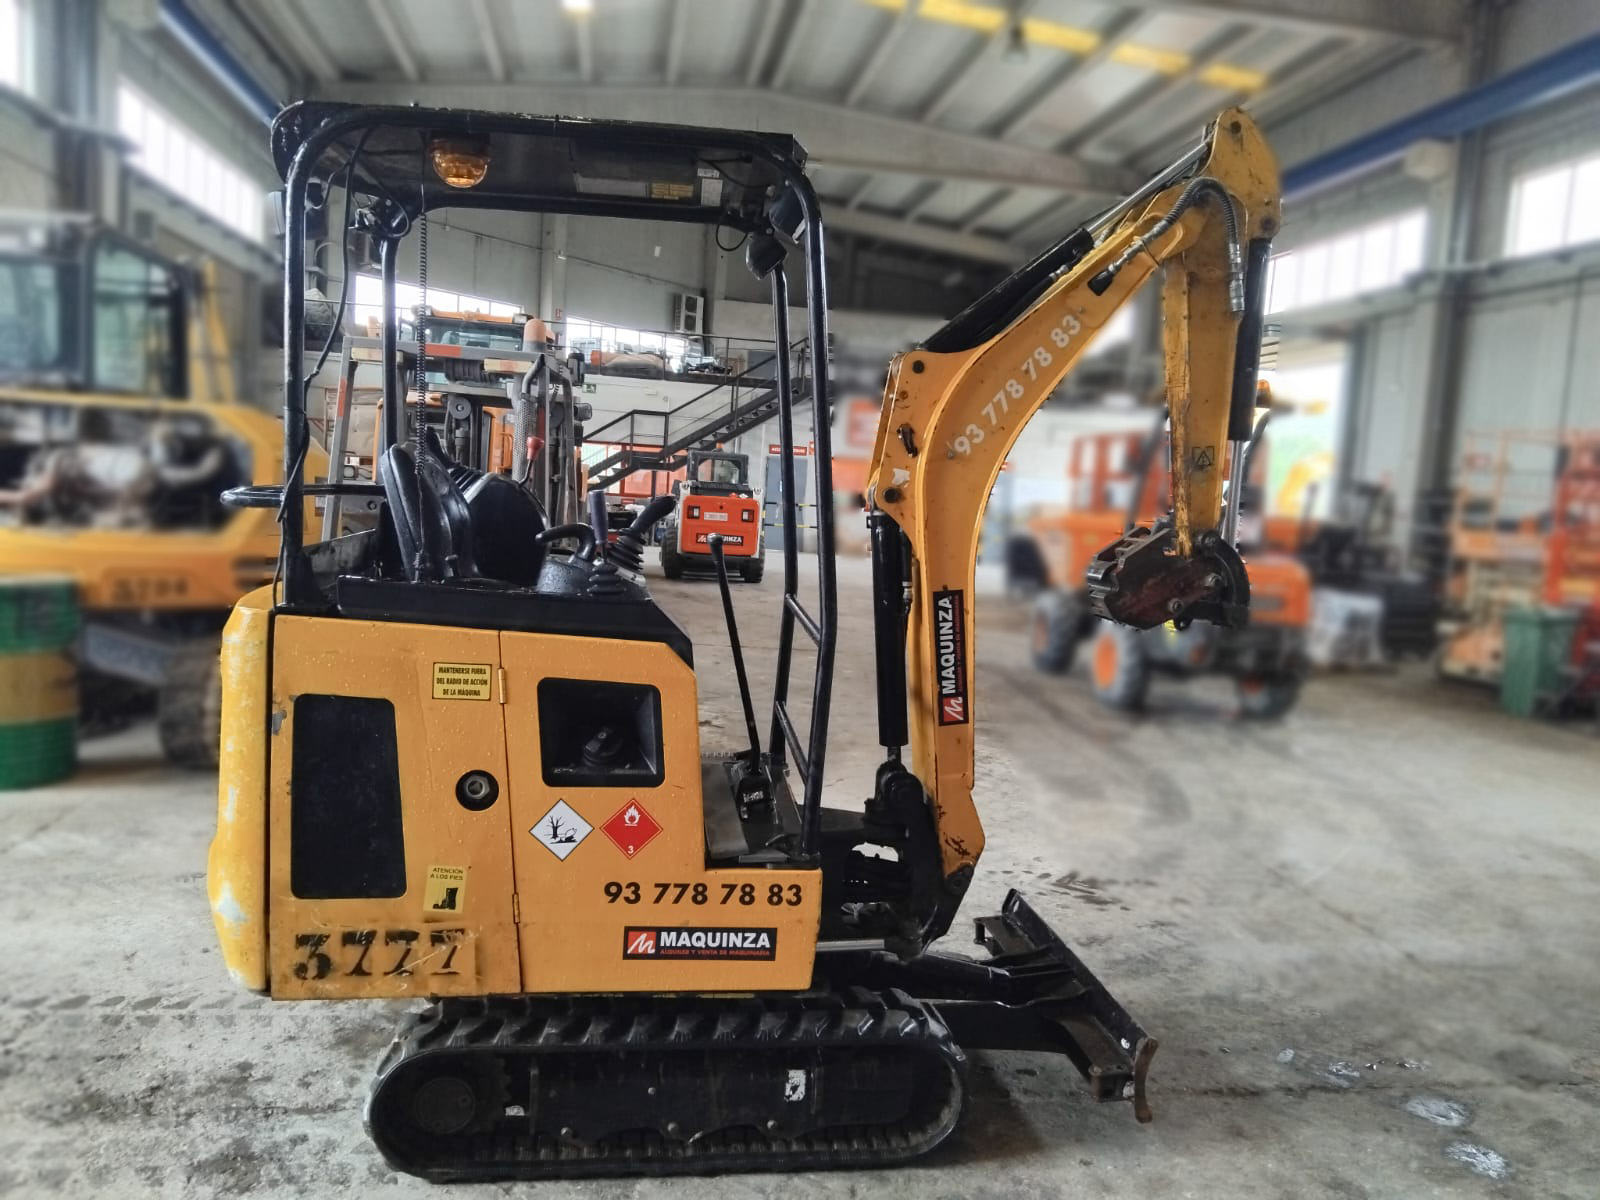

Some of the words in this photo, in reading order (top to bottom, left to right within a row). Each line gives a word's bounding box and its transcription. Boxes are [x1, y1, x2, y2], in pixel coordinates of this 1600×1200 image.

[954, 424, 985, 456] 93
[981, 379, 1024, 426] 778
[1021, 346, 1052, 381] 78
[1051, 315, 1081, 348] 83
[938, 597, 956, 694] MAQUINZA
[627, 845, 634, 854] 3
[604, 881, 641, 904] 93
[653, 882, 708, 906] 778
[719, 883, 756, 906] 78
[767, 883, 803, 907] 83
[294, 929, 466, 981] 3777
[660, 931, 771, 948] MAQUINZA
